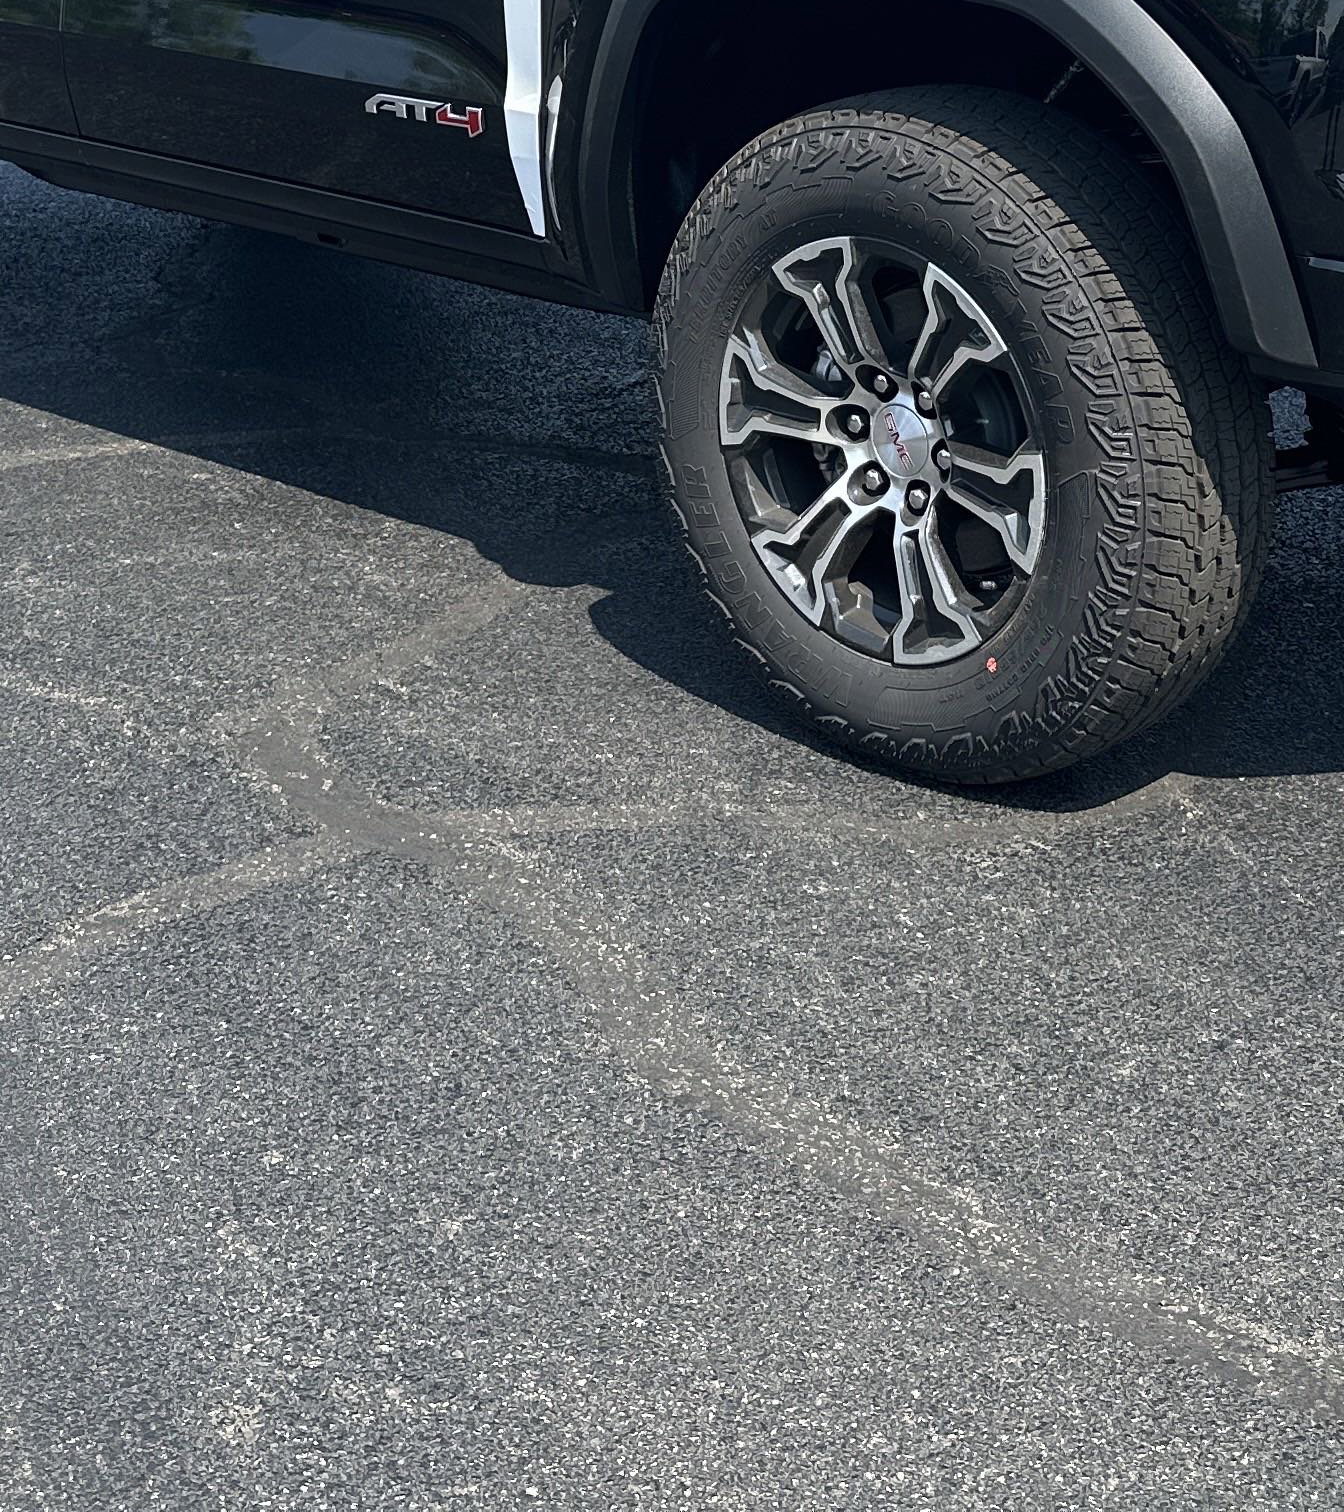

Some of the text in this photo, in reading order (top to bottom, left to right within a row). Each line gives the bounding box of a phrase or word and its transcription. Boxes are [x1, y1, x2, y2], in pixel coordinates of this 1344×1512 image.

[364, 93, 483, 138] AT4
[884, 412, 915, 470] GMC
[679, 462, 854, 707] WRANGLER
